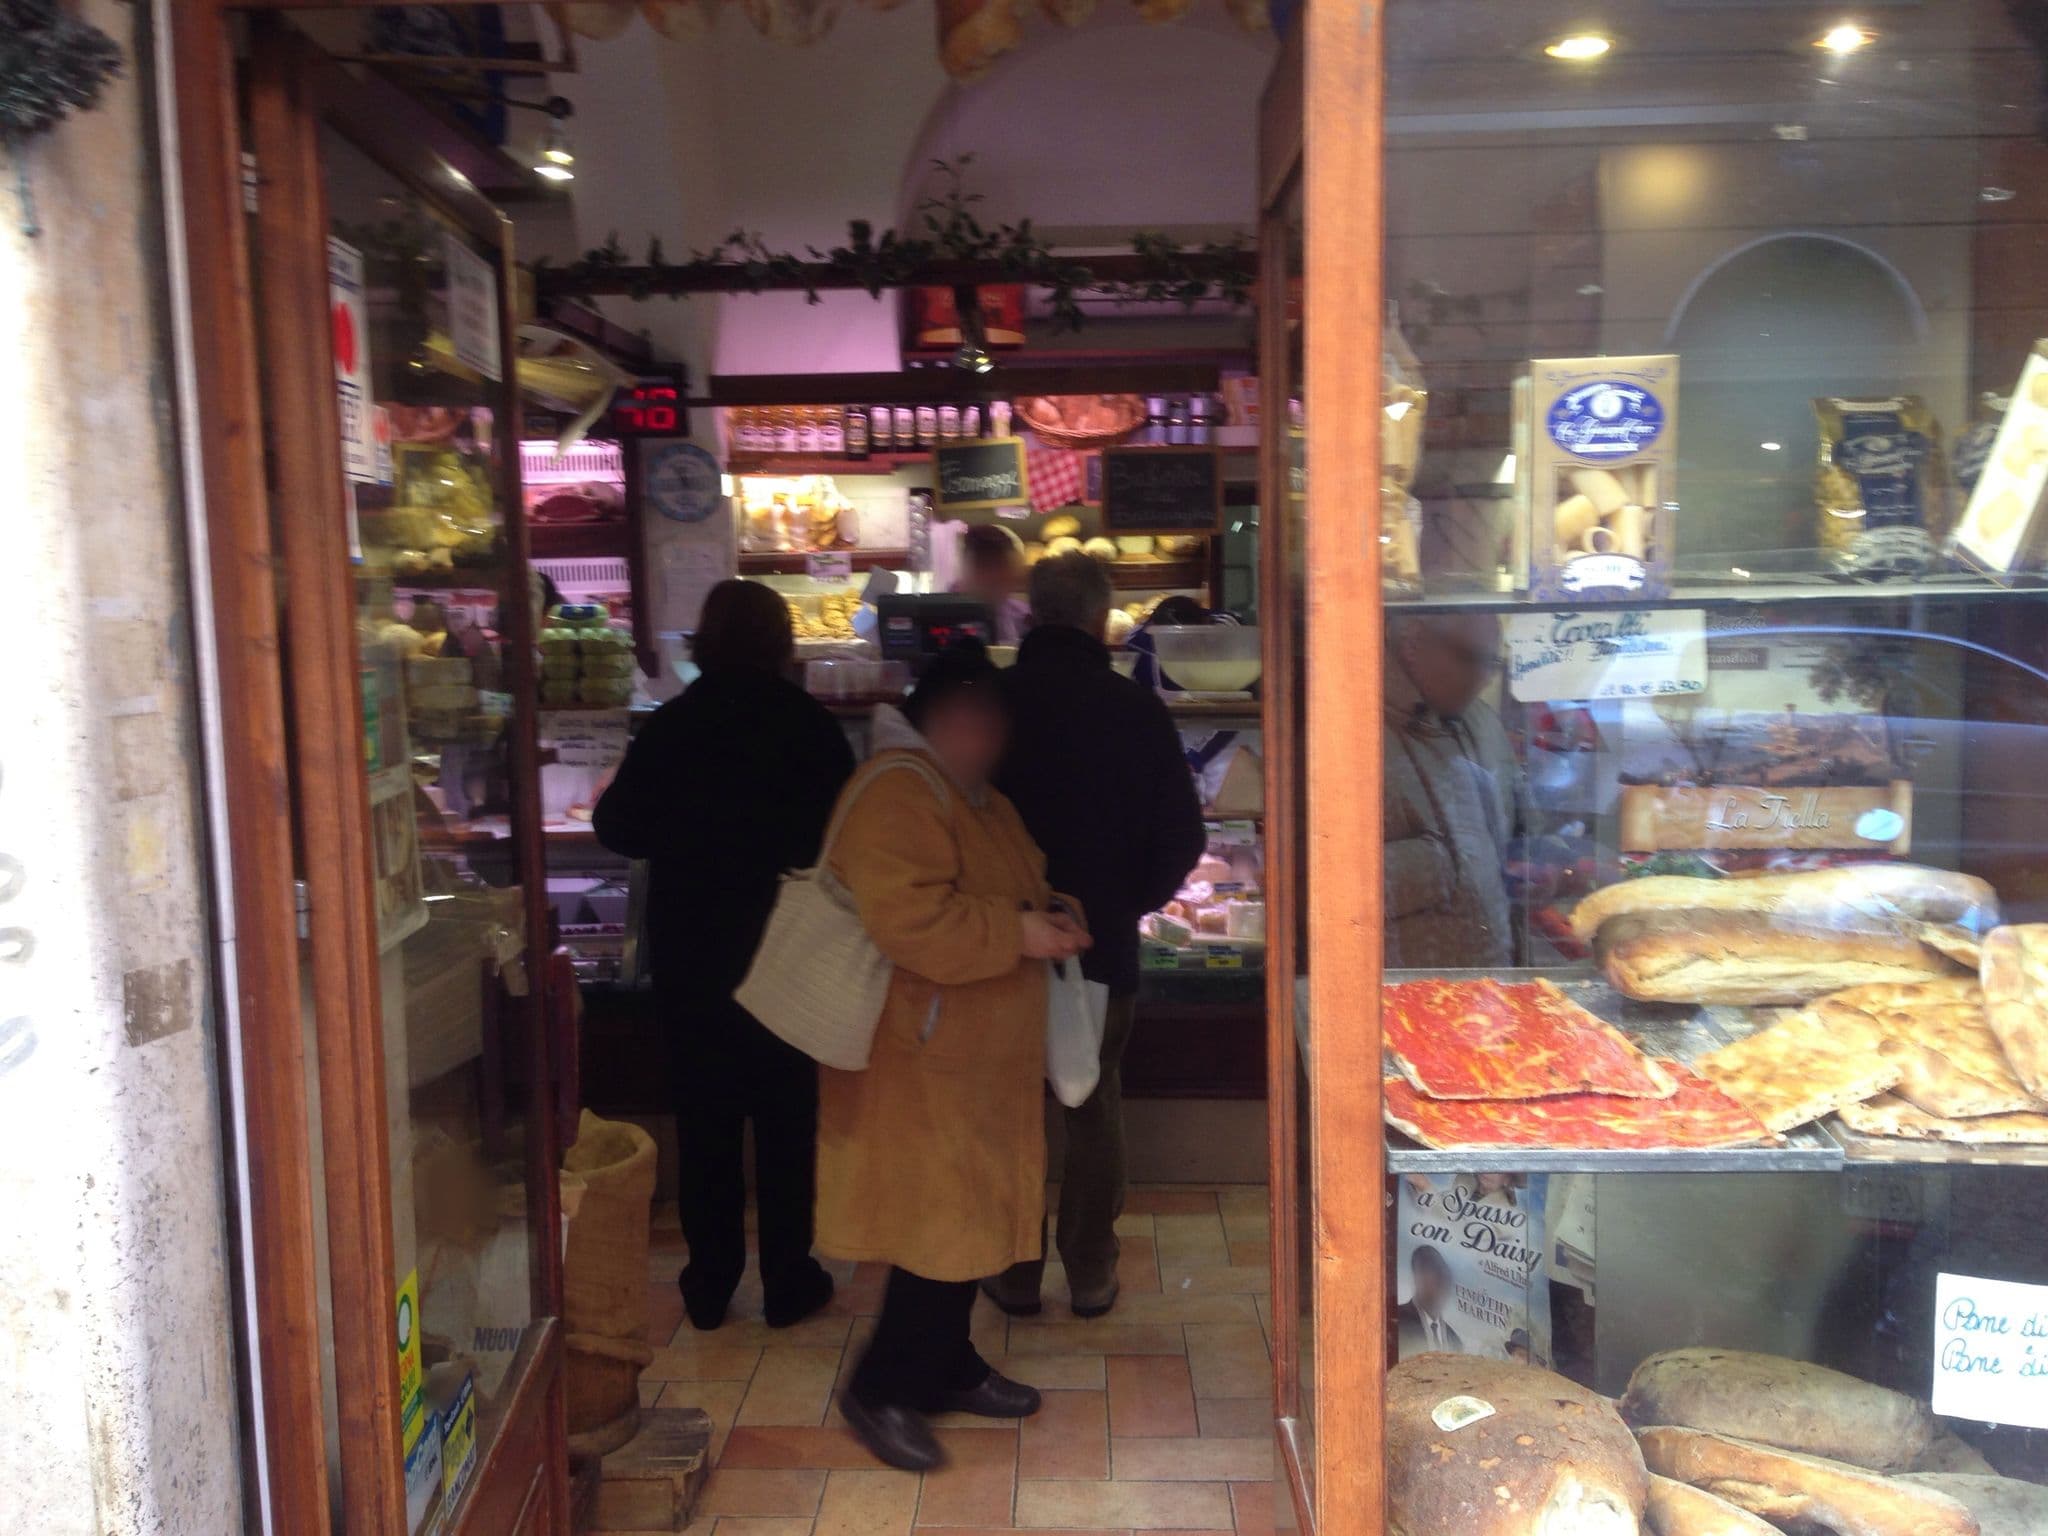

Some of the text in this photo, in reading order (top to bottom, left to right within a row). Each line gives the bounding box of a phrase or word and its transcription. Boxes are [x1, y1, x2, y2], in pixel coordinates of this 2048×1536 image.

[1706, 796, 1750, 830] La
[1417, 1185, 1527, 1229] a Spasso
[1411, 1221, 1543, 1272] con Daisy
[1455, 1284, 1513, 1316] TIMOTHY
[1457, 1299, 1508, 1328] MARTIN
[1943, 1297, 2010, 1334] Pane
[1942, 1338, 2004, 1374] Pane
